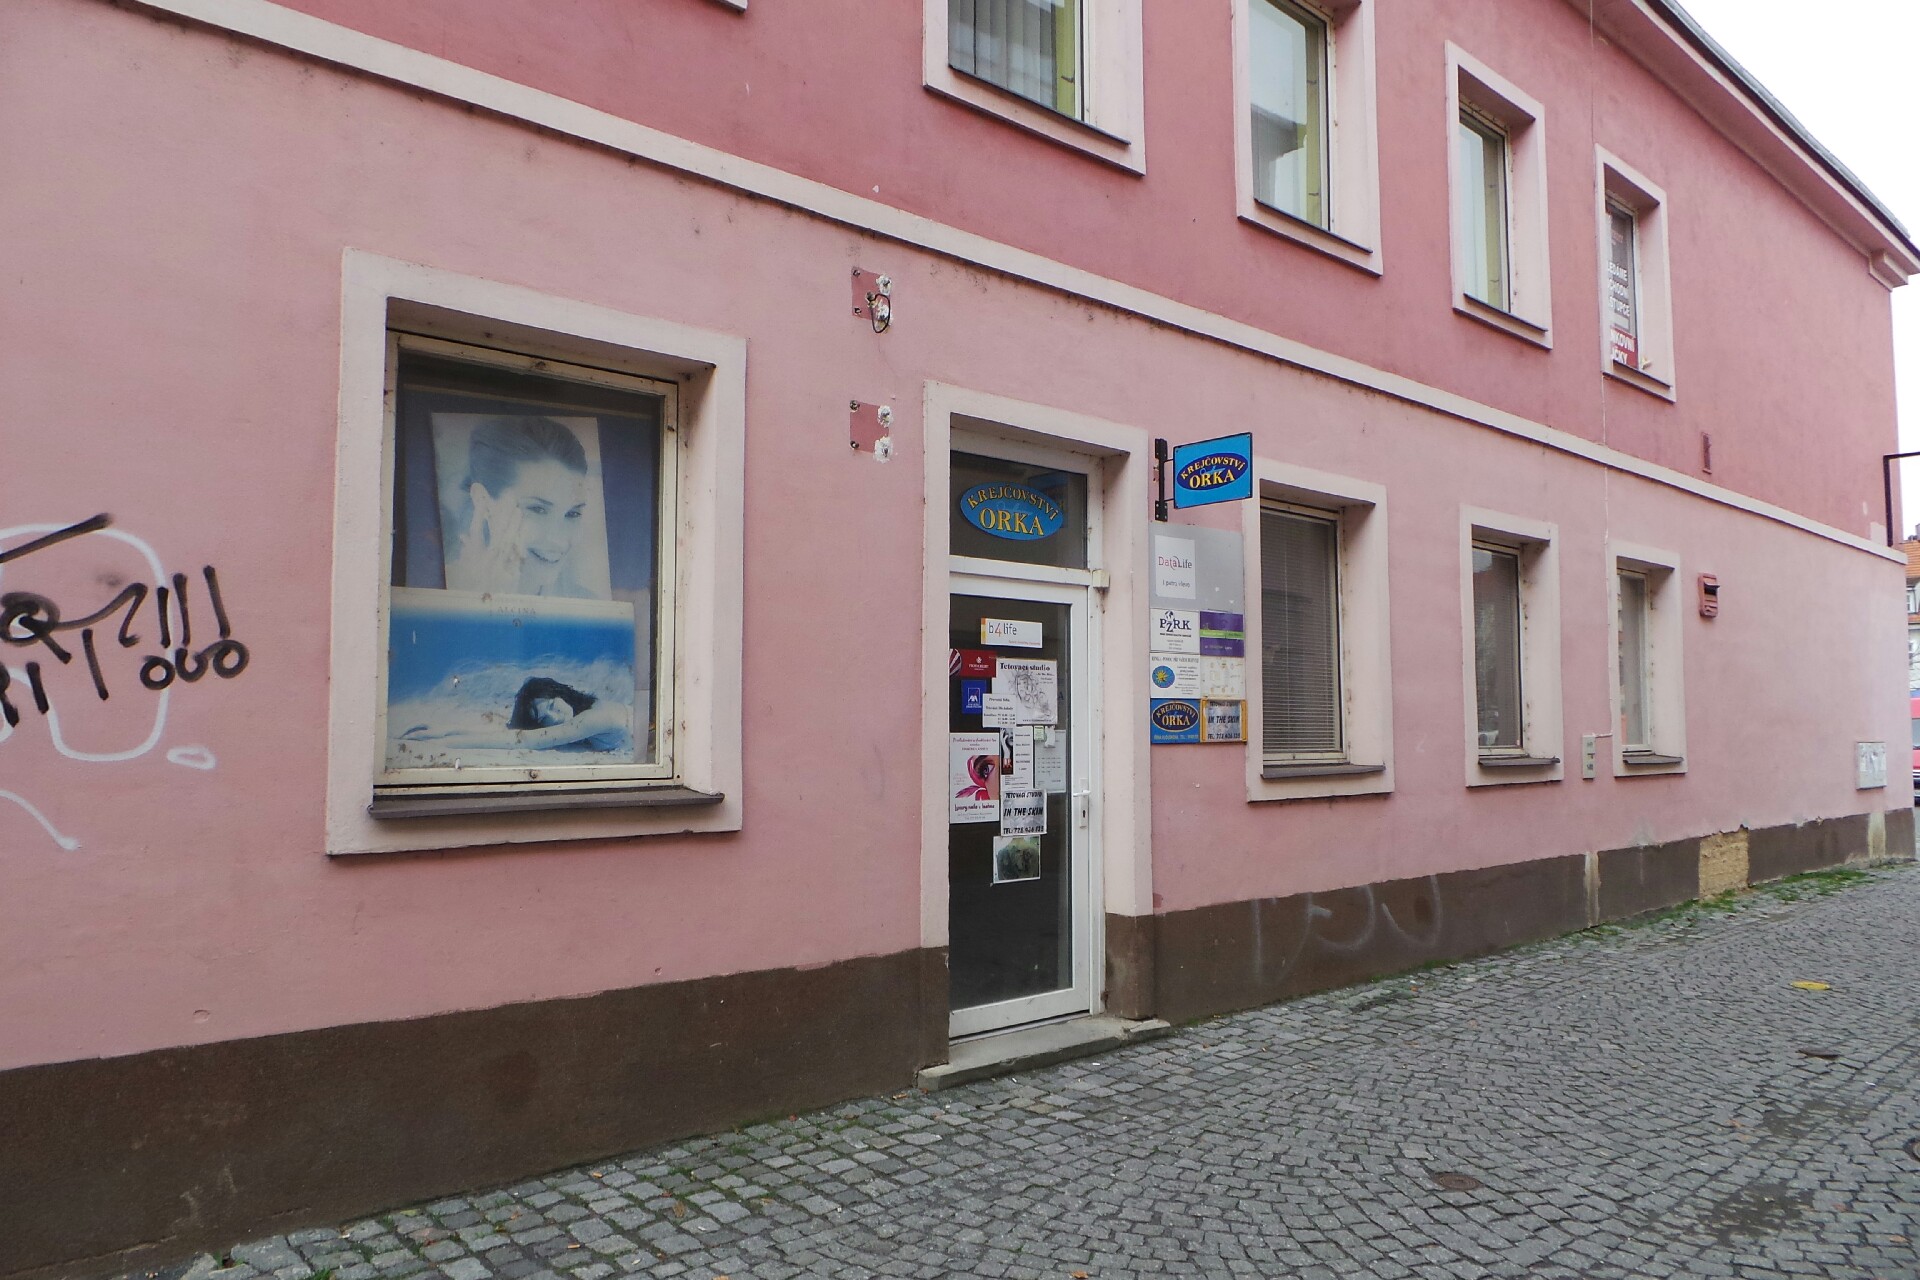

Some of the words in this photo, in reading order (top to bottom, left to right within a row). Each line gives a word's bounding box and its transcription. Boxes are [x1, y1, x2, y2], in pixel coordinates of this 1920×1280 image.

[1180, 456, 1246, 480] KREJČOVSTVÍ
[1189, 469, 1235, 488] ORKA
[967, 484, 1059, 521] KREJČOVSTVÍ
[979, 508, 1044, 536] ORKA
[1158, 556, 1193, 570] DataLife
[1162, 715, 1191, 726] ORKA
[1014, 807, 1026, 816] THE
[1027, 807, 1044, 816] SKIN
